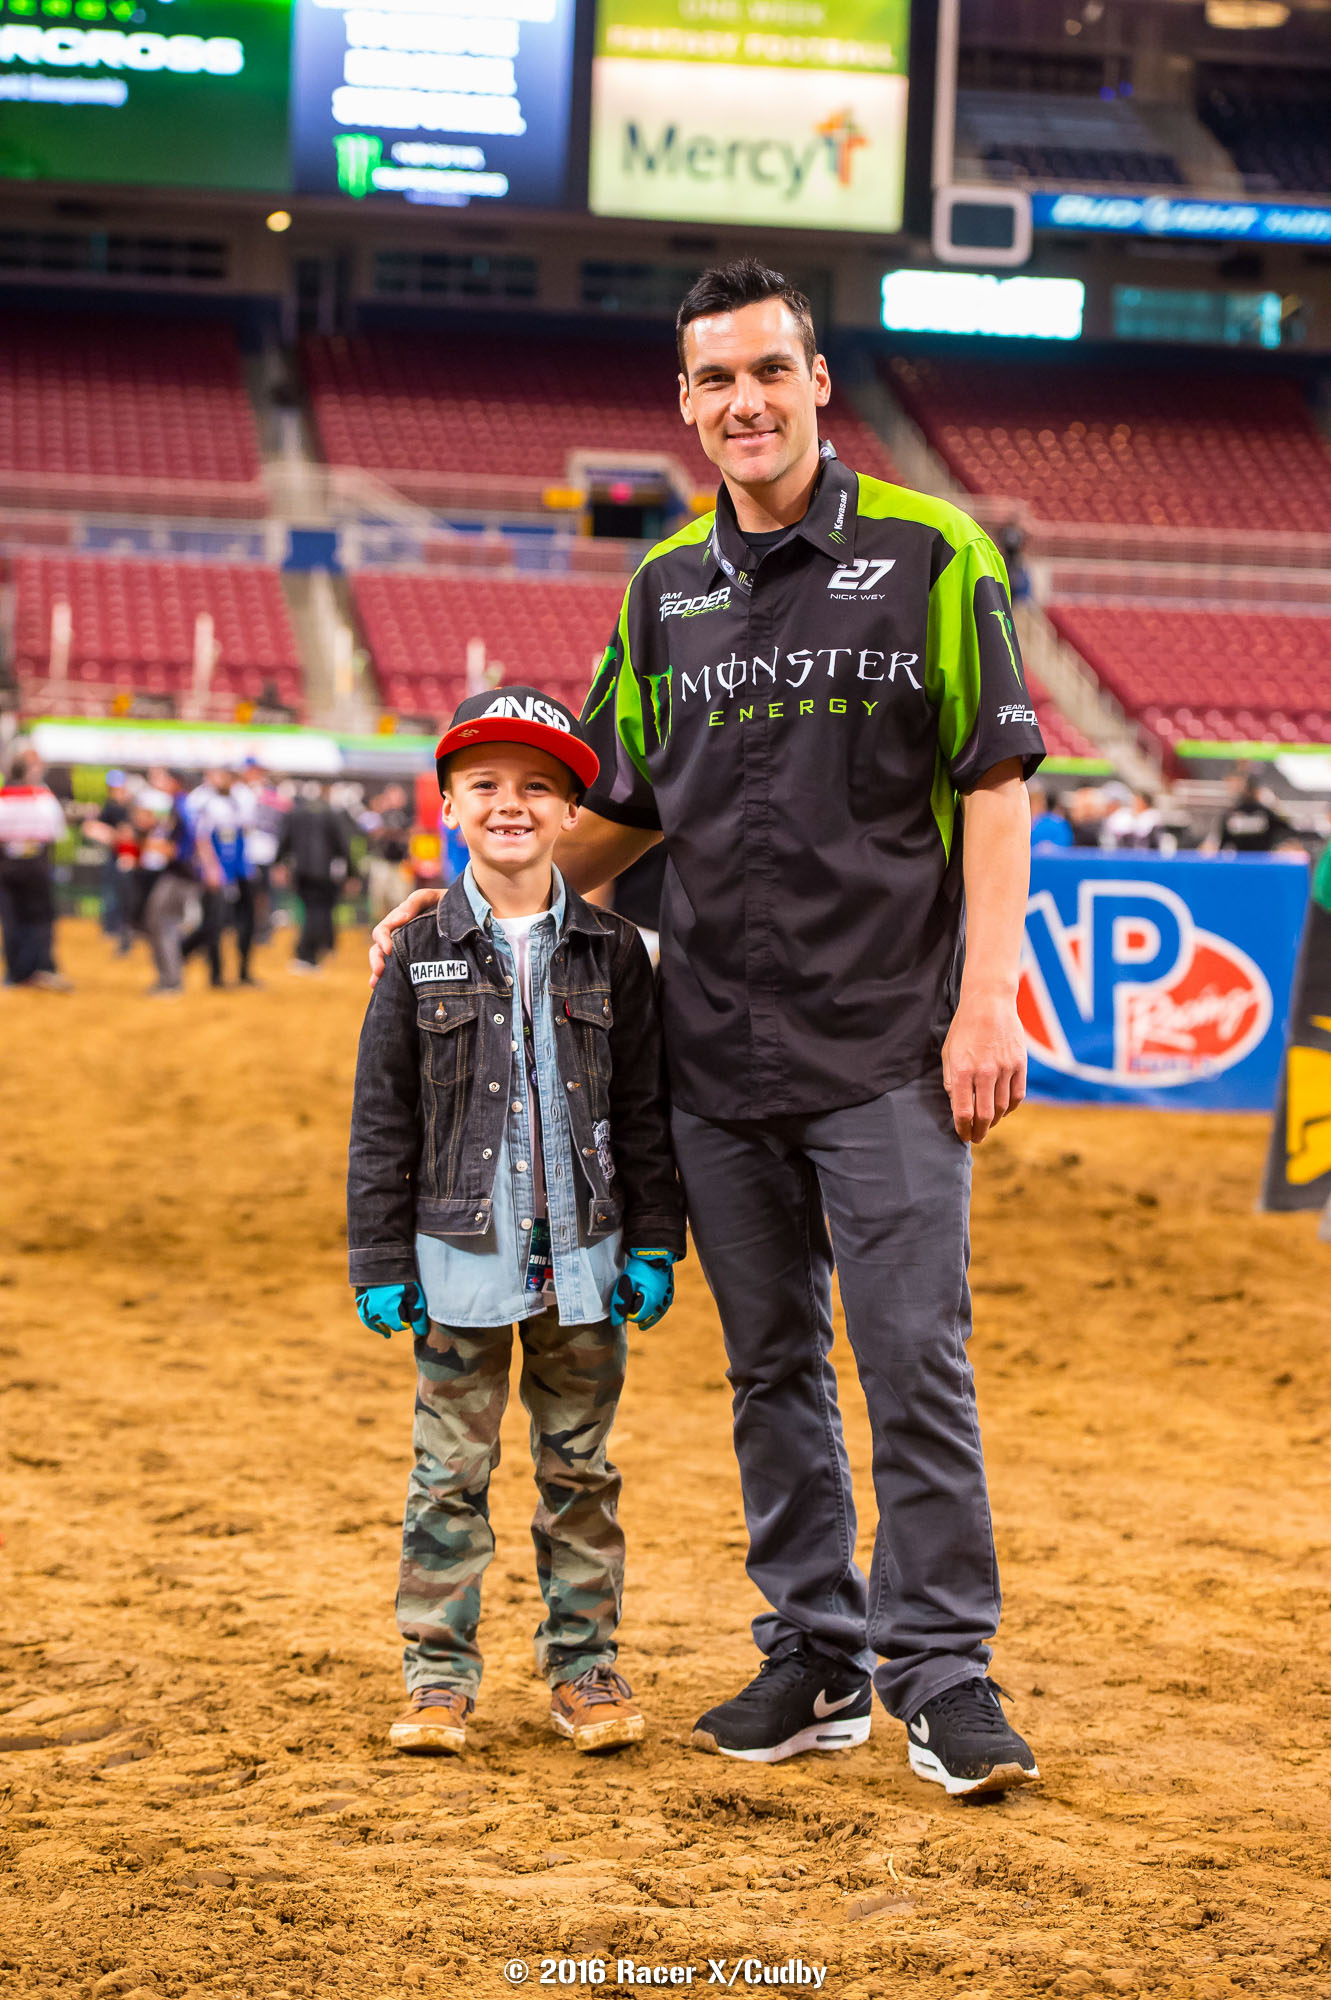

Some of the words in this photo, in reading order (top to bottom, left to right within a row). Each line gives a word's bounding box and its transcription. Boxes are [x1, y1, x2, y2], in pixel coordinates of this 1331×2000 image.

[622, 117, 816, 199] Mercy
[833, 489, 848, 530] Kawasaki
[827, 559, 896, 591] 27
[830, 593, 857, 601] NICK
[860, 593, 886, 601] WEY
[681, 646, 923, 703] MONSTER
[709, 698, 879, 726] ENERGY
[999, 704, 1026, 712] TEAM
[411, 964, 445, 981] MAFIA
[1022, 879, 1196, 1072] VP
